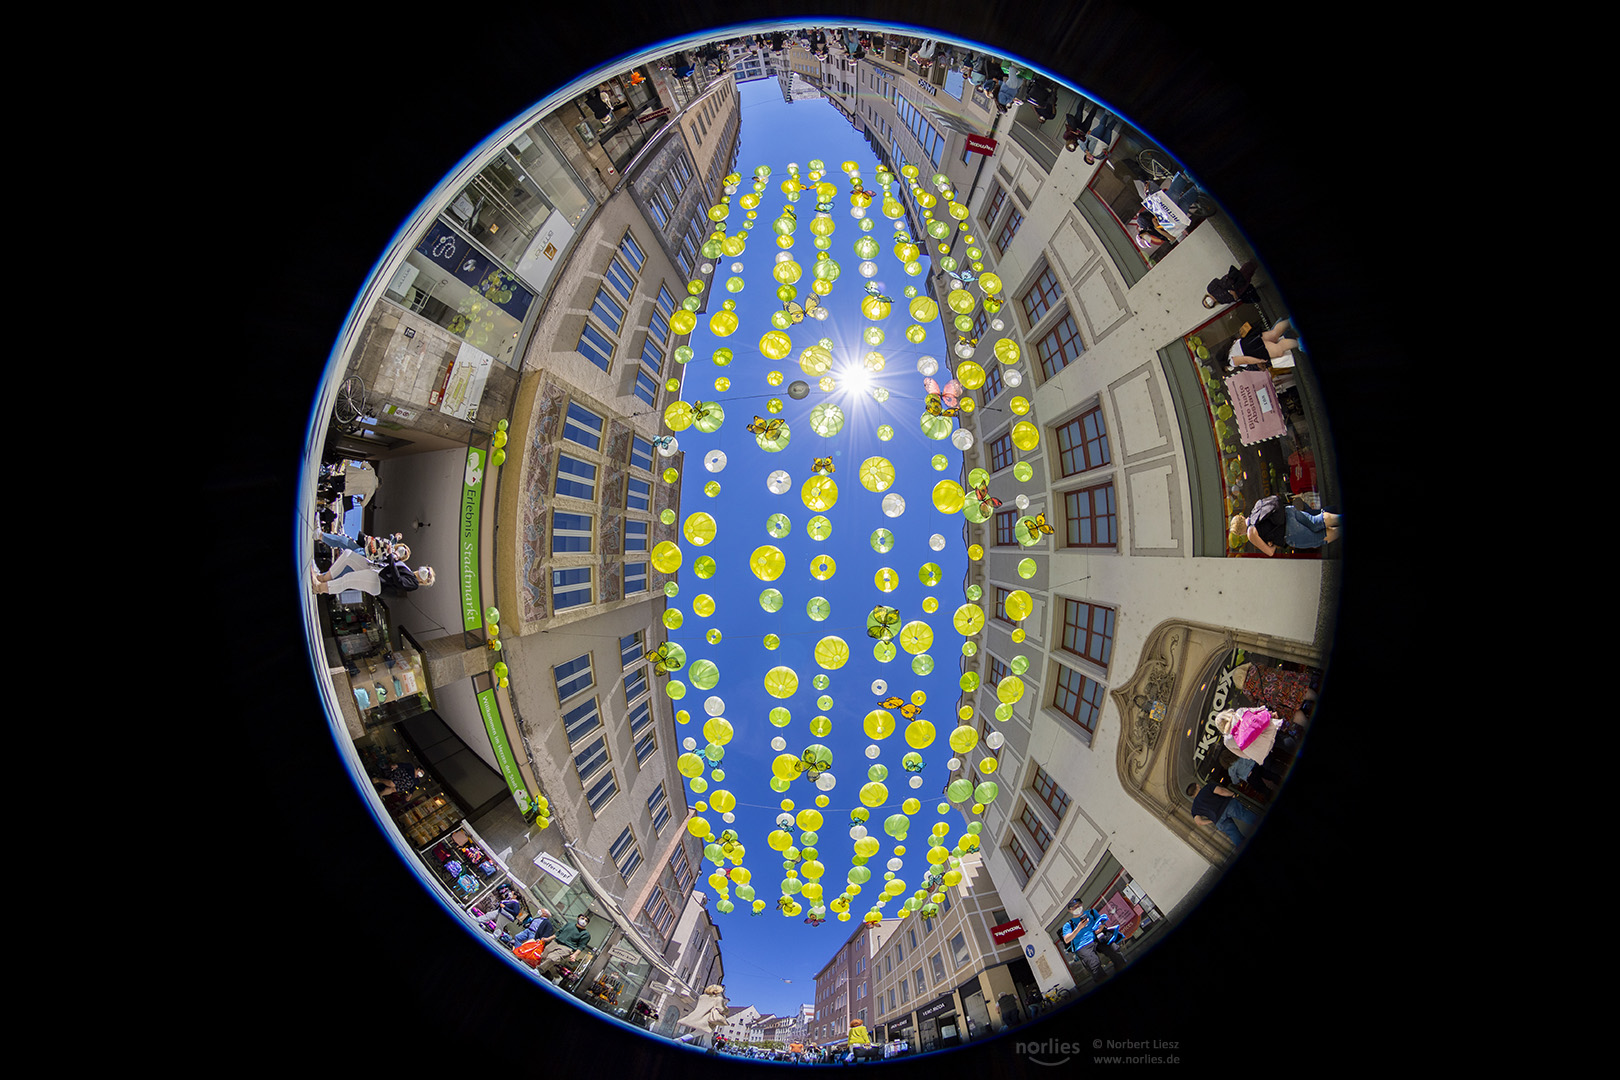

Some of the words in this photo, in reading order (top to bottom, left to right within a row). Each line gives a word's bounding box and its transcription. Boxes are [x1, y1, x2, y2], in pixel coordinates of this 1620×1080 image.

[918, 78, 936, 96] MANGO
[1158, 201, 1179, 221] ACTION
[533, 229, 554, 260] ammer
[1239, 384, 1248, 406] halte
[1244, 386, 1259, 423] Abstand
[1245, 408, 1255, 429] Bitte
[464, 489, 475, 537] Erlebnis
[464, 542, 477, 621] Stadtmarkt
[482, 695, 497, 735] Willkommen
[494, 735, 500, 743] im
[497, 744, 507, 764] Herzen
[508, 773, 518, 789] Stadt
[540, 857, 570, 879] koffer-kopf
